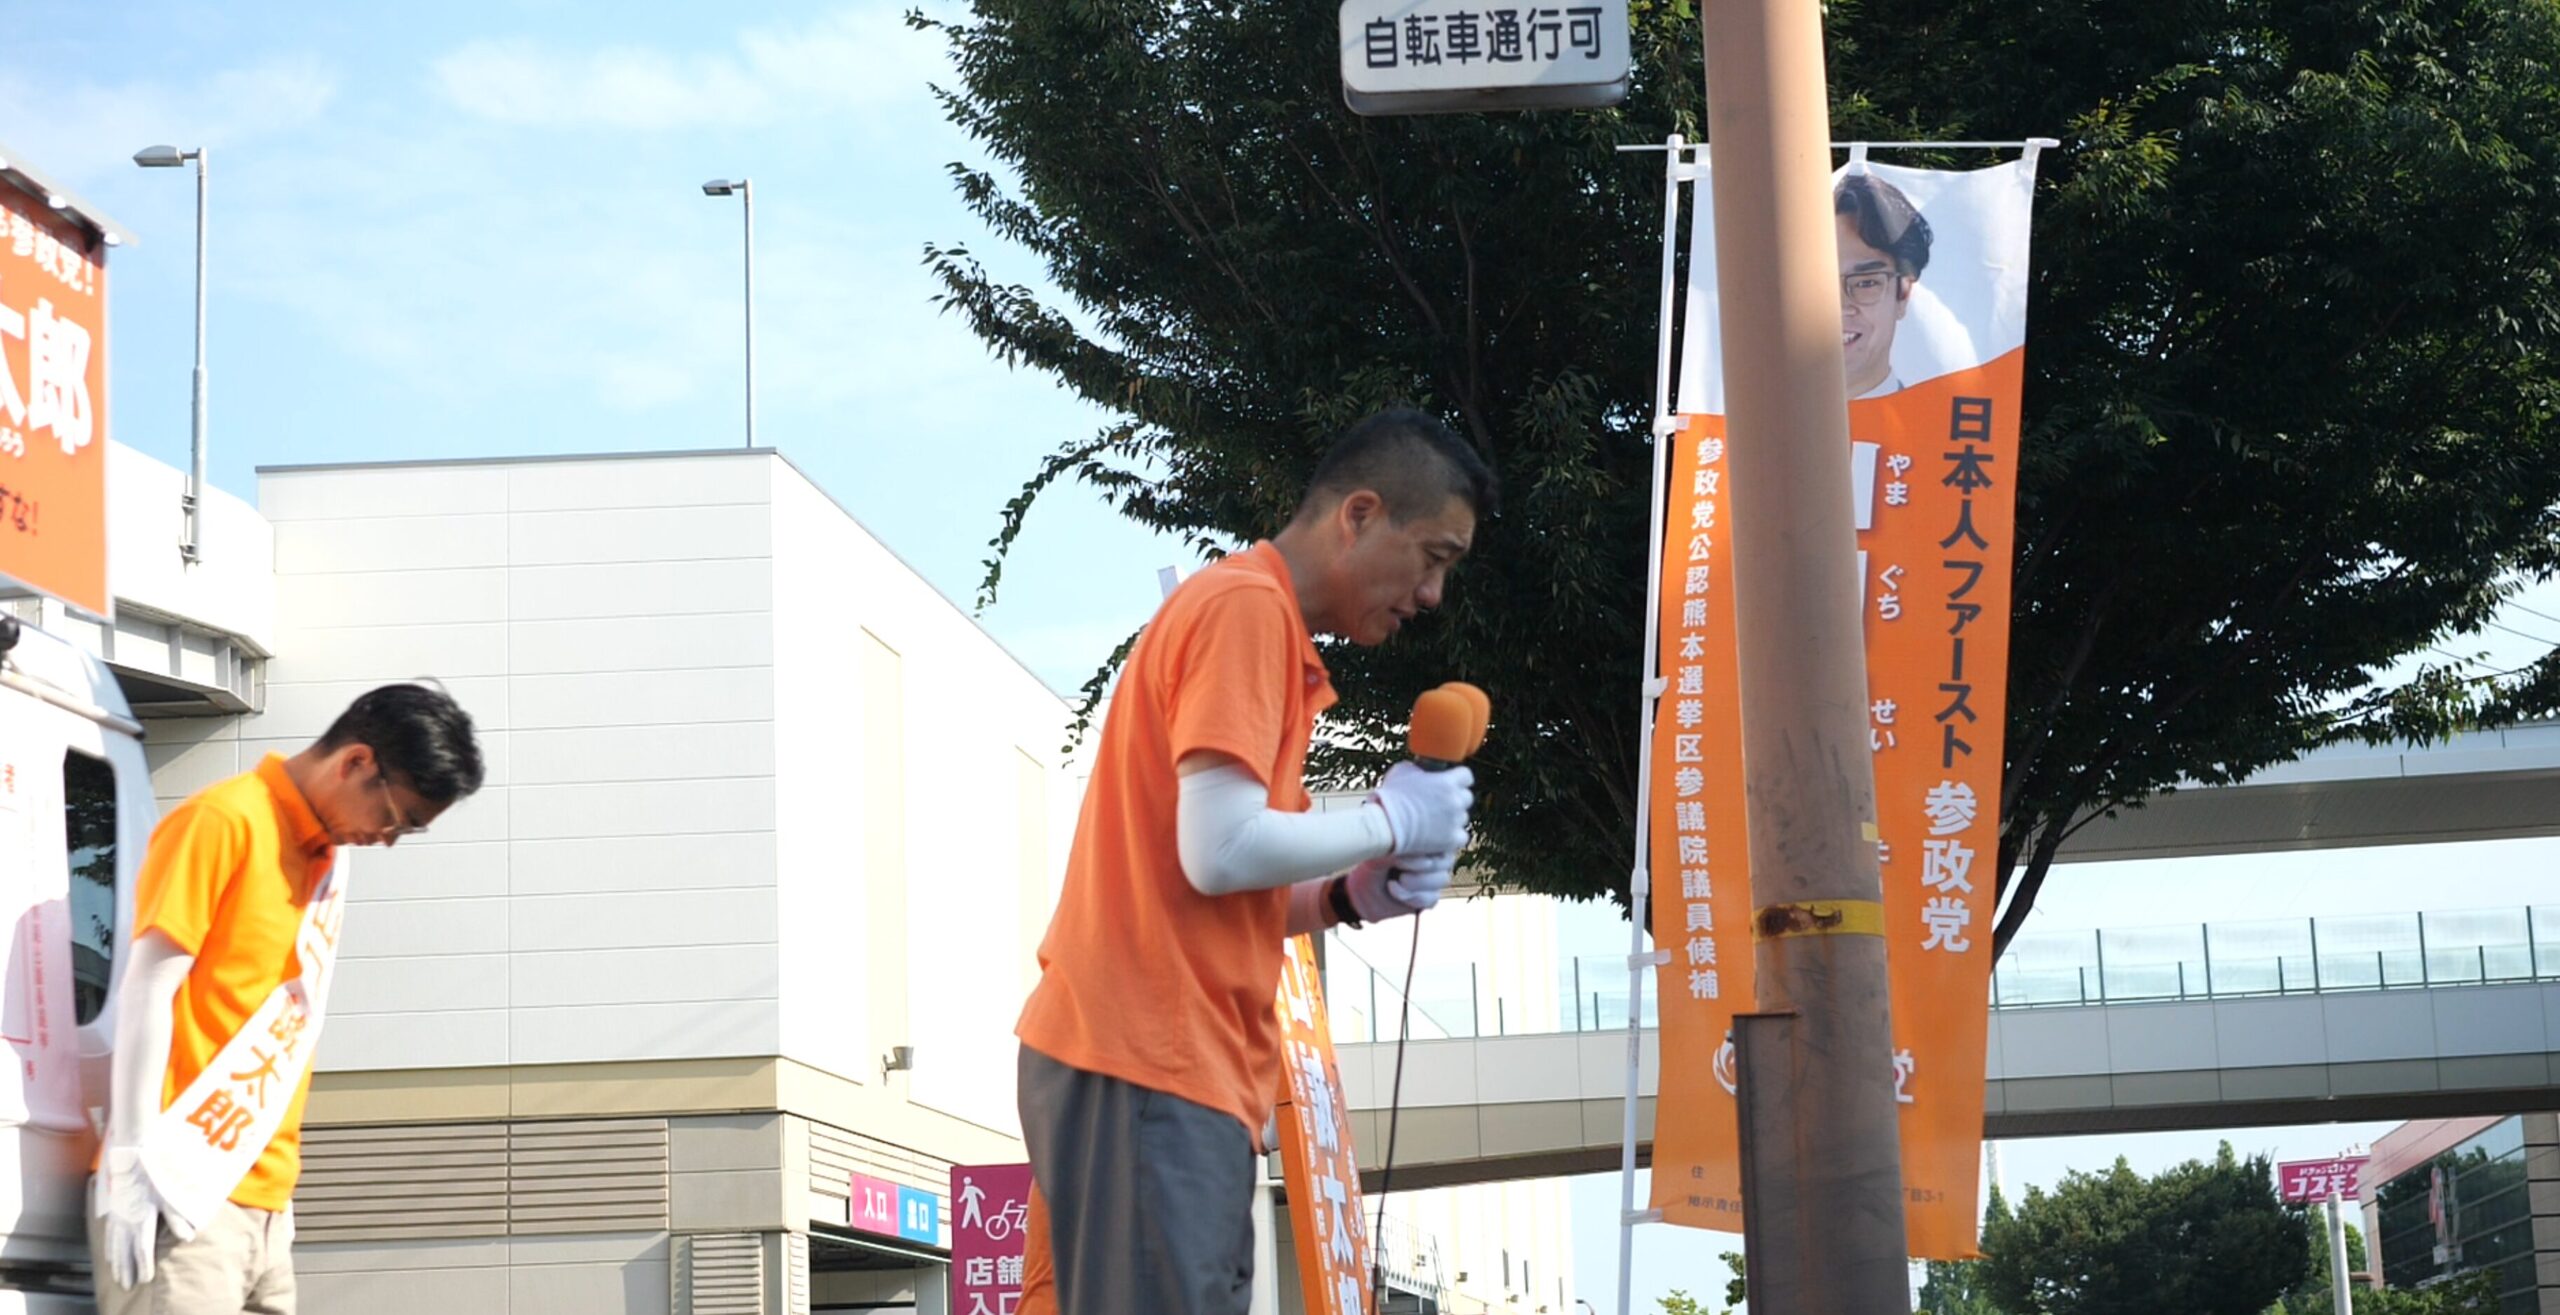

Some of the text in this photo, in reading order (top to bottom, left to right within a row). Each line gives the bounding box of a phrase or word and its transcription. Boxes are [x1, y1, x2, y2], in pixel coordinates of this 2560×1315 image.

[1365, 7, 1602, 68] 自転車通行可
[1870, 454, 1911, 752] やま ぐち せい
[1921, 396, 1994, 952] 日本人ファースト 参政党
[1675, 437, 1724, 998] 参政党公認熊本選挙区参議院議員候補
[864, 1187, 888, 1221] 入口
[965, 1255, 1024, 1286] 店舗
